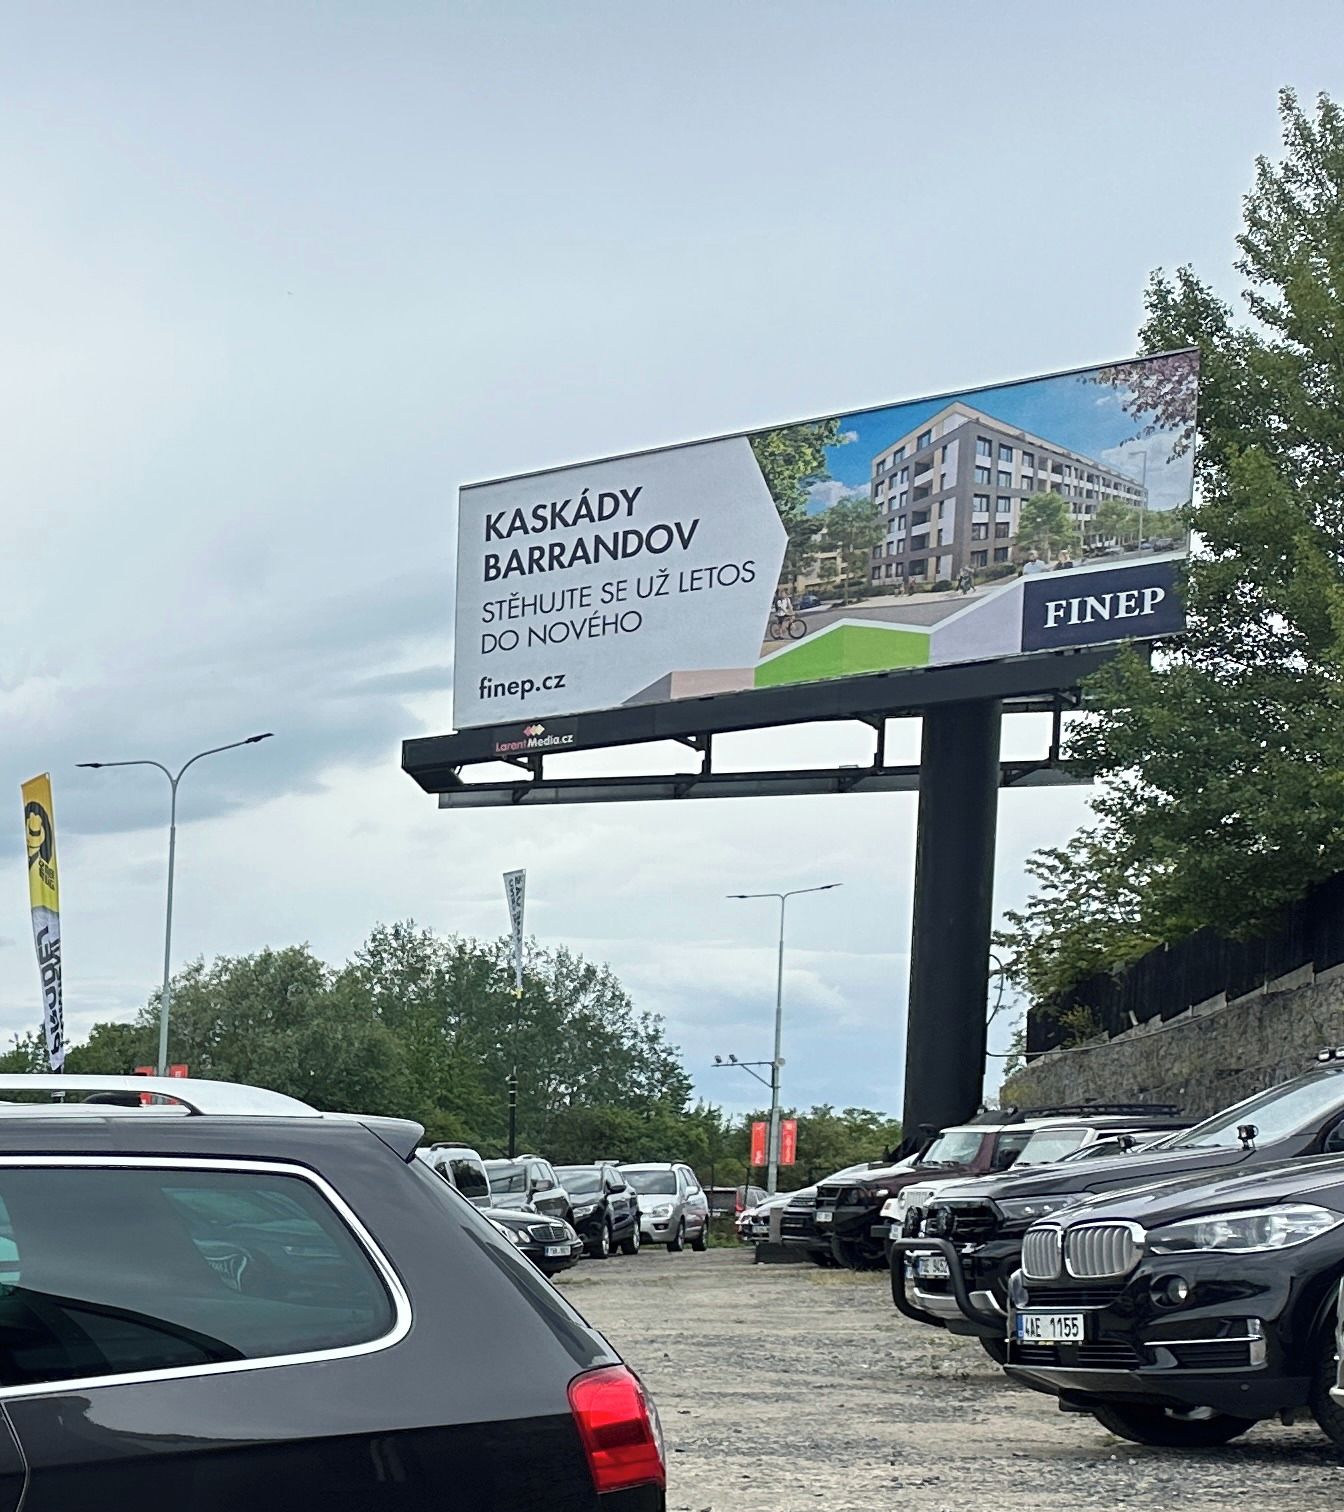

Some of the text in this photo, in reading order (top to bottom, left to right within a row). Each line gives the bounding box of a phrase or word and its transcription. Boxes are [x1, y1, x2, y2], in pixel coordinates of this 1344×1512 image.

[484, 486, 643, 542] KASKÁDY
[483, 518, 700, 582] BARRANDOV
[481, 559, 756, 624] STĚHUJTE SE UŽ LETOS
[1043, 587, 1166, 628] FINEP
[481, 610, 643, 655] DO NOVÉHO
[478, 673, 566, 700] finep.cz
[1025, 1316, 1080, 1338] 4AE 1155
